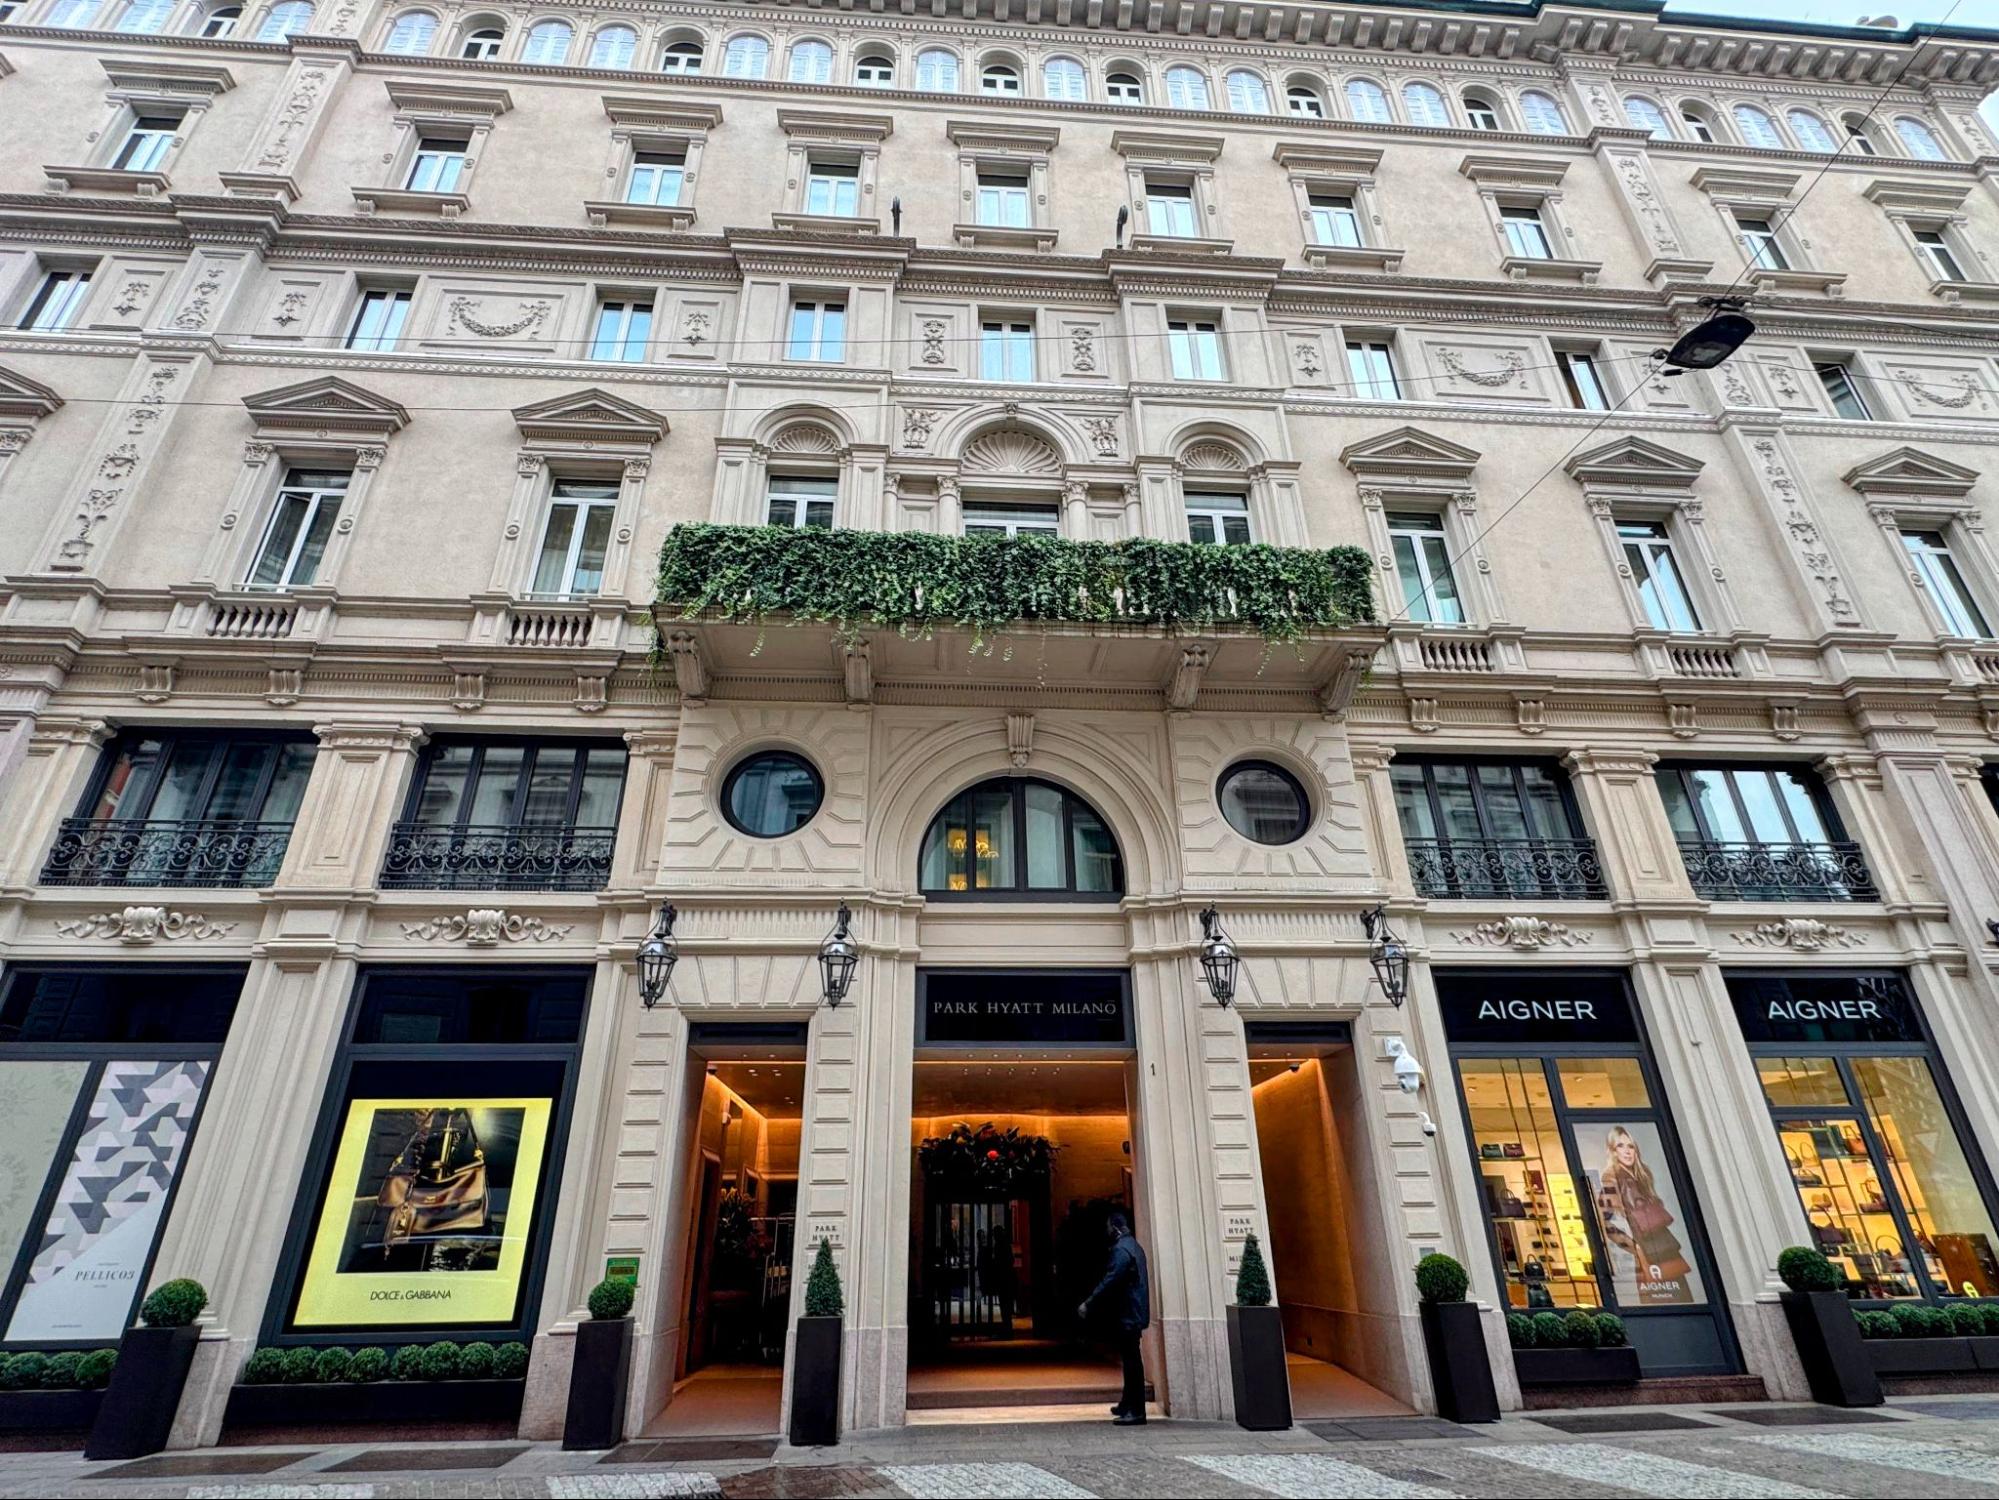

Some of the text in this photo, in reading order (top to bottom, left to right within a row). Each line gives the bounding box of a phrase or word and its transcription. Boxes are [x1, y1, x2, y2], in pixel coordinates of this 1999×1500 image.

[934, 1002, 1117, 1015] PARK HYATT MILANO
[1478, 1000, 1598, 1020] AIGNER
[1768, 1000, 1882, 1020] AIGNER
[1150, 1062, 1156, 1076] 1
[1640, 1281, 1681, 1291] AIGNER
[370, 1290, 400, 1301] DOLCE
[405, 1289, 452, 1300] GABBANA
